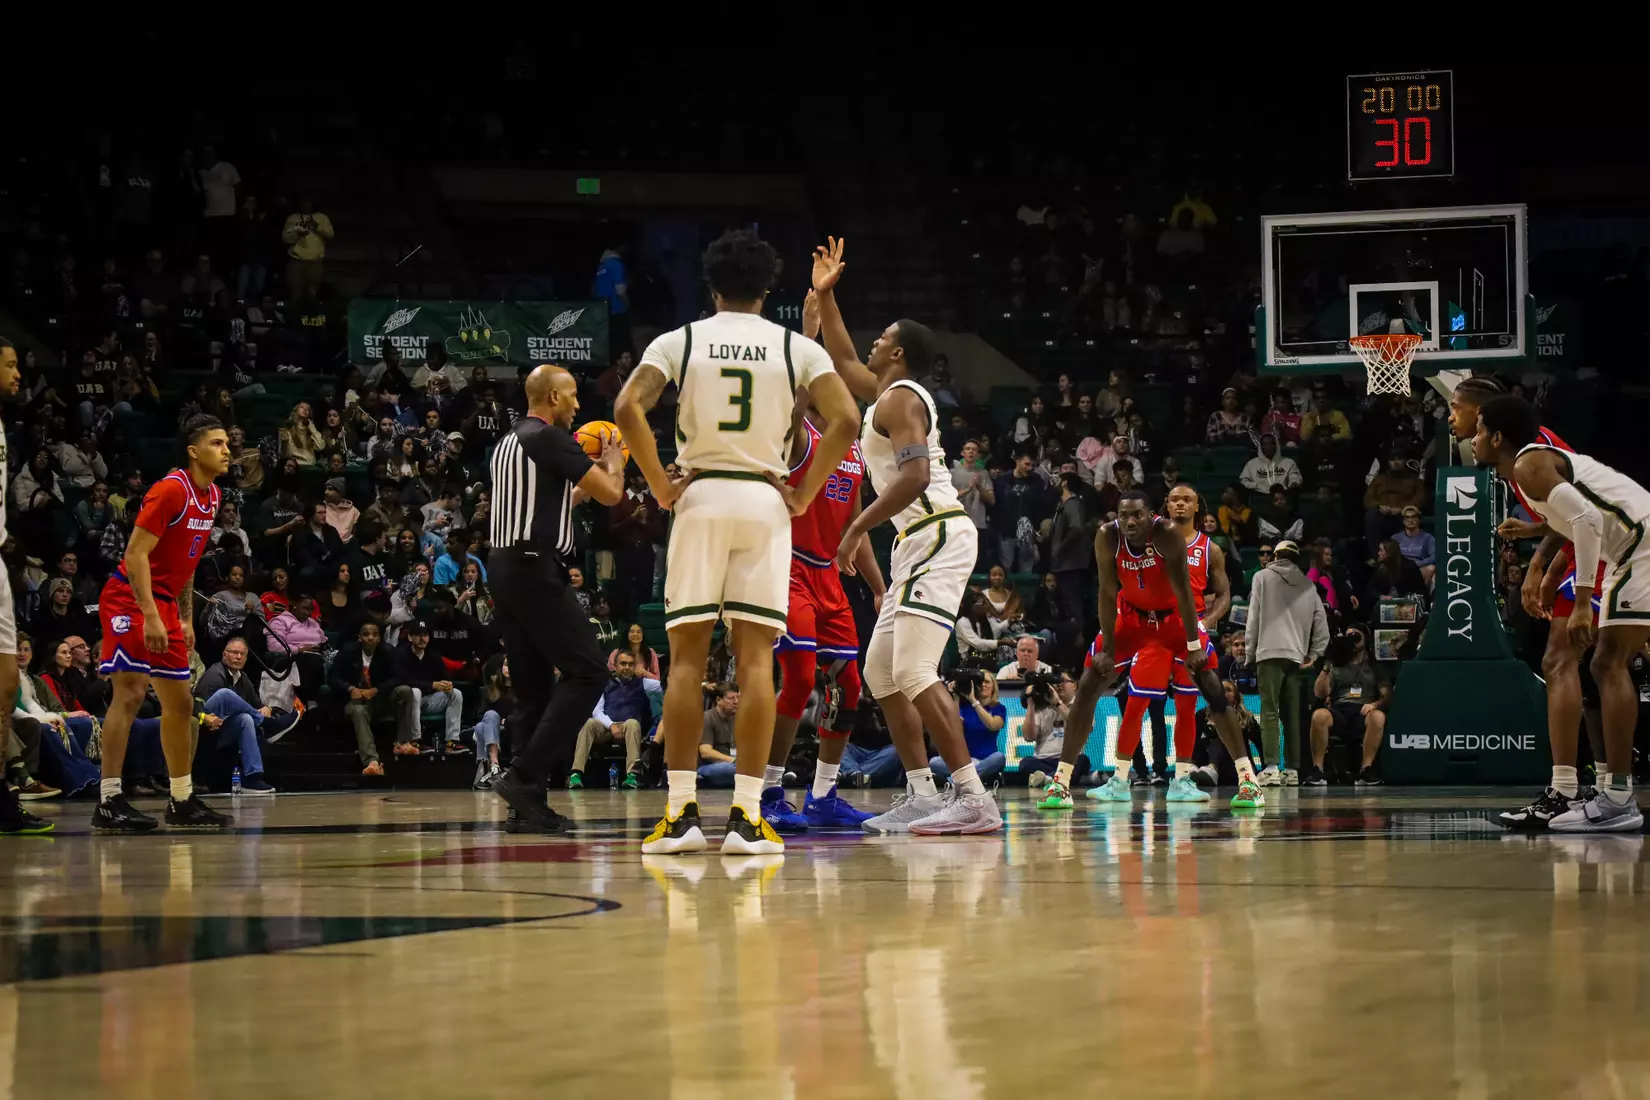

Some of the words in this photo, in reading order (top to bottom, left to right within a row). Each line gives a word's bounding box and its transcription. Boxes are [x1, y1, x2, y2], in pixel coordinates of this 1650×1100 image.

[1375, 74, 1425, 82] DAKTRONICS
[1362, 87, 1395, 113] 20
[1407, 84, 1441, 111] 00
[1375, 117, 1431, 167] 30
[777, 305, 799, 319] 111
[363, 334, 429, 347] STDENT
[527, 336, 593, 348] STUDENT
[366, 346, 427, 359] SEION
[529, 348, 591, 360] SECTION
[709, 343, 767, 361] LOVAN
[718, 367, 753, 432] 3
[825, 474, 853, 503] 22
[1446, 511, 1477, 643] LEGACY
[1390, 734, 1430, 750] UAB
[1433, 734, 1536, 750] MEDICINE
